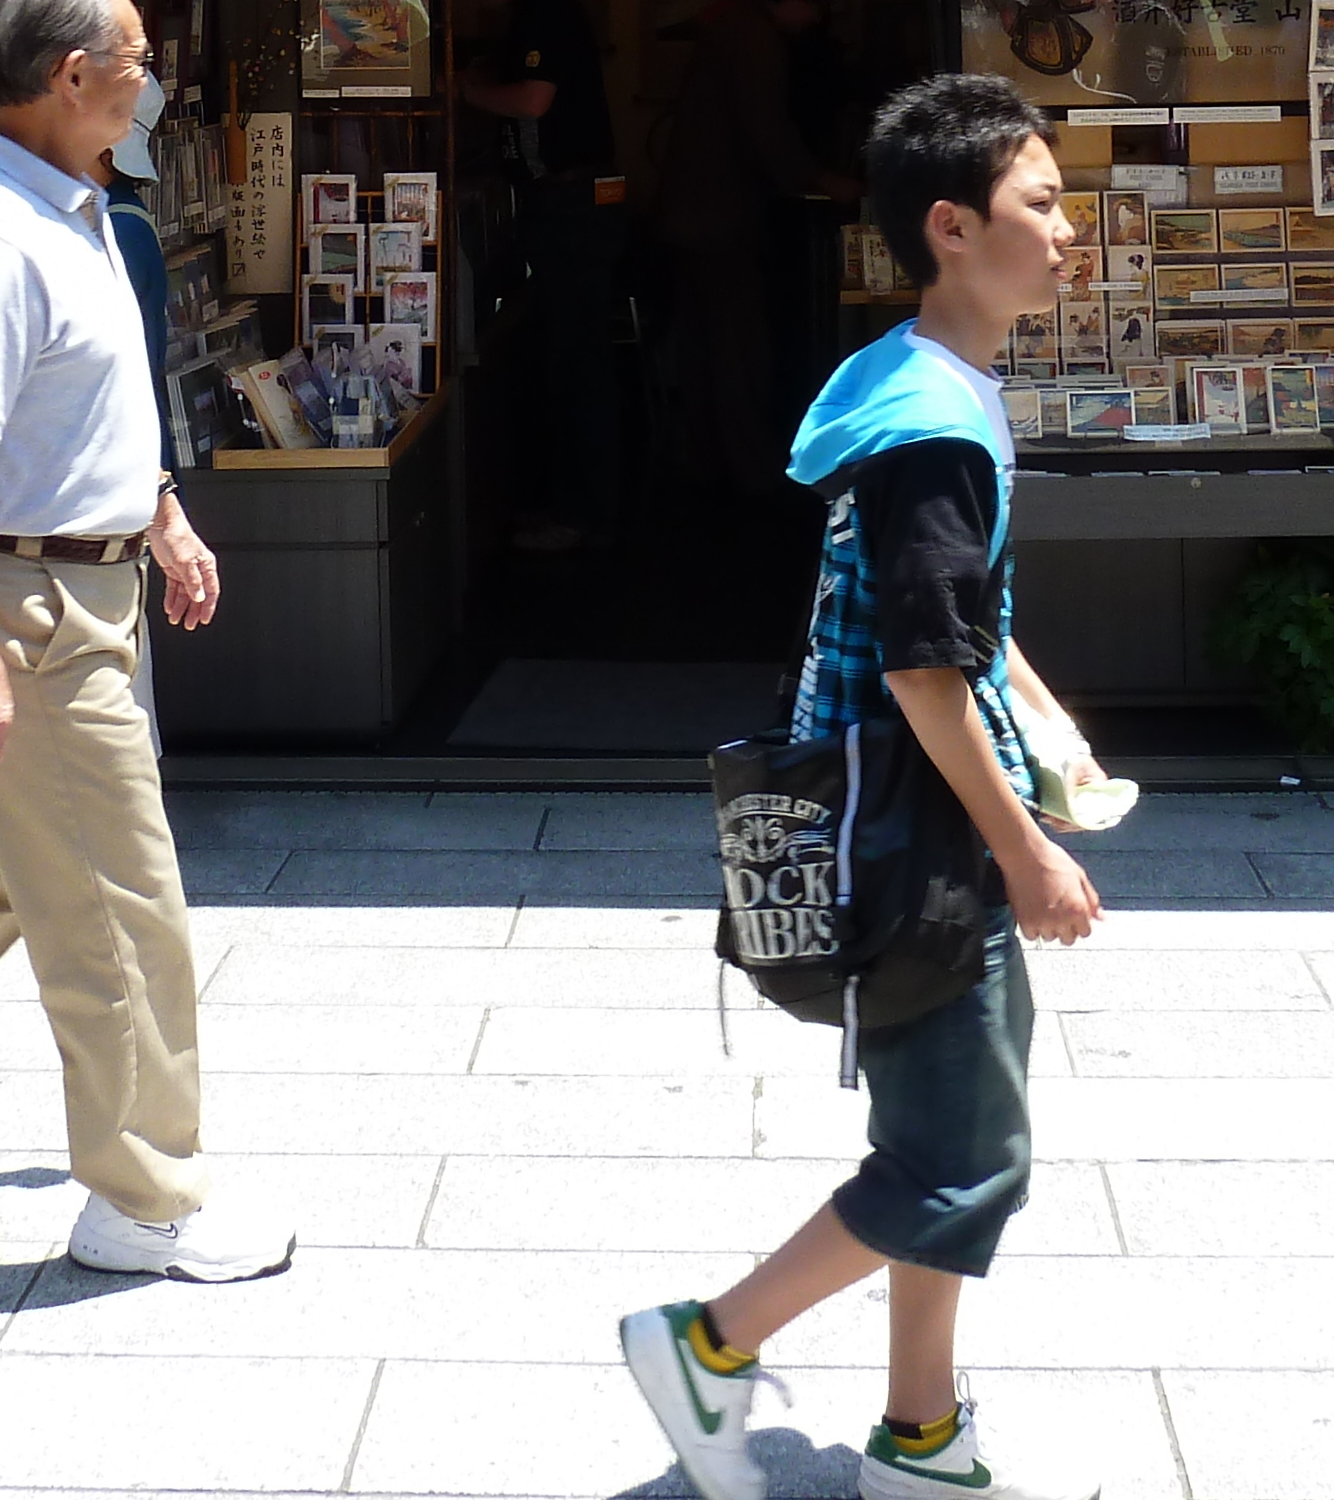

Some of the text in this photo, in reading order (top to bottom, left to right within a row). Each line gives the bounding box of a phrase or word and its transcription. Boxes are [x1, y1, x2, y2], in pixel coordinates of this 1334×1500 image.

[250, 128, 267, 260] 江戸時代の浮世絵や
[270, 124, 286, 188] 店内には
